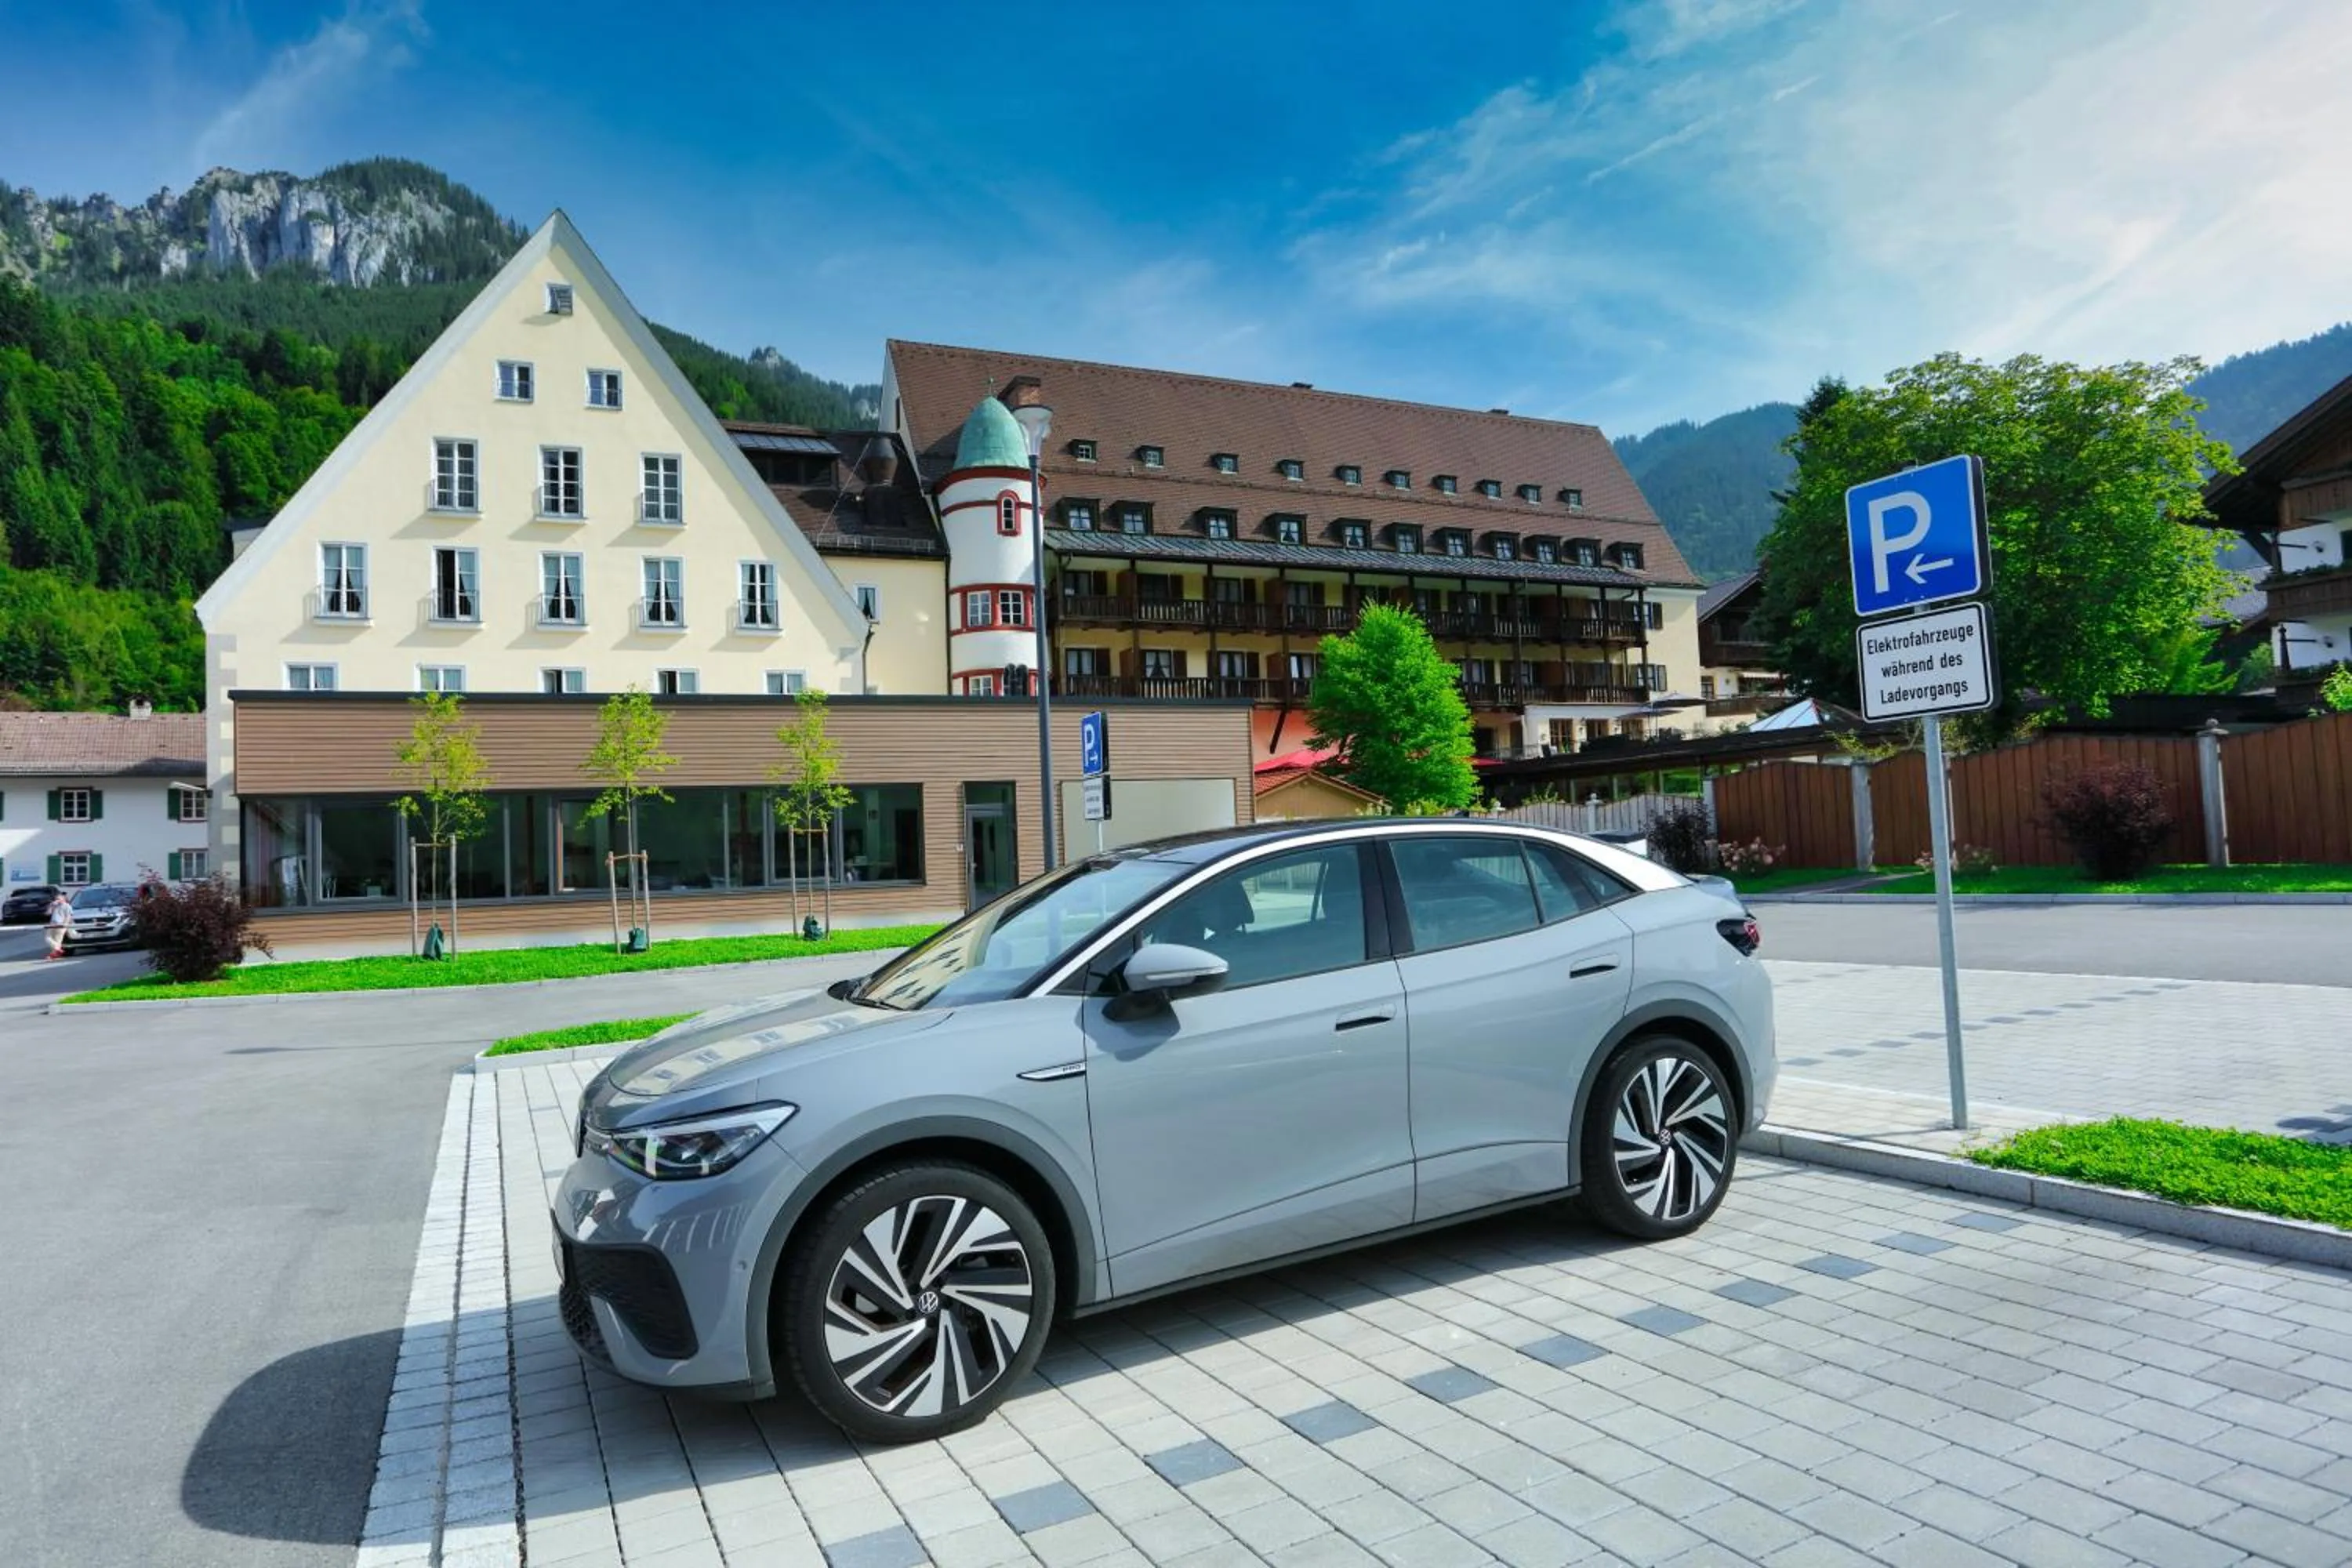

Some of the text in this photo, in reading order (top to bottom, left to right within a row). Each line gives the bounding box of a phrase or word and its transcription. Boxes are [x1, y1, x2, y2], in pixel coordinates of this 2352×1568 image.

[1868, 491, 1931, 593] P
[1867, 625, 1974, 655] Elektrofahrzeuge
[1881, 652, 1963, 678] während des
[1881, 681, 1969, 704] Ladevorgangs
[1083, 724, 1095, 768] P
